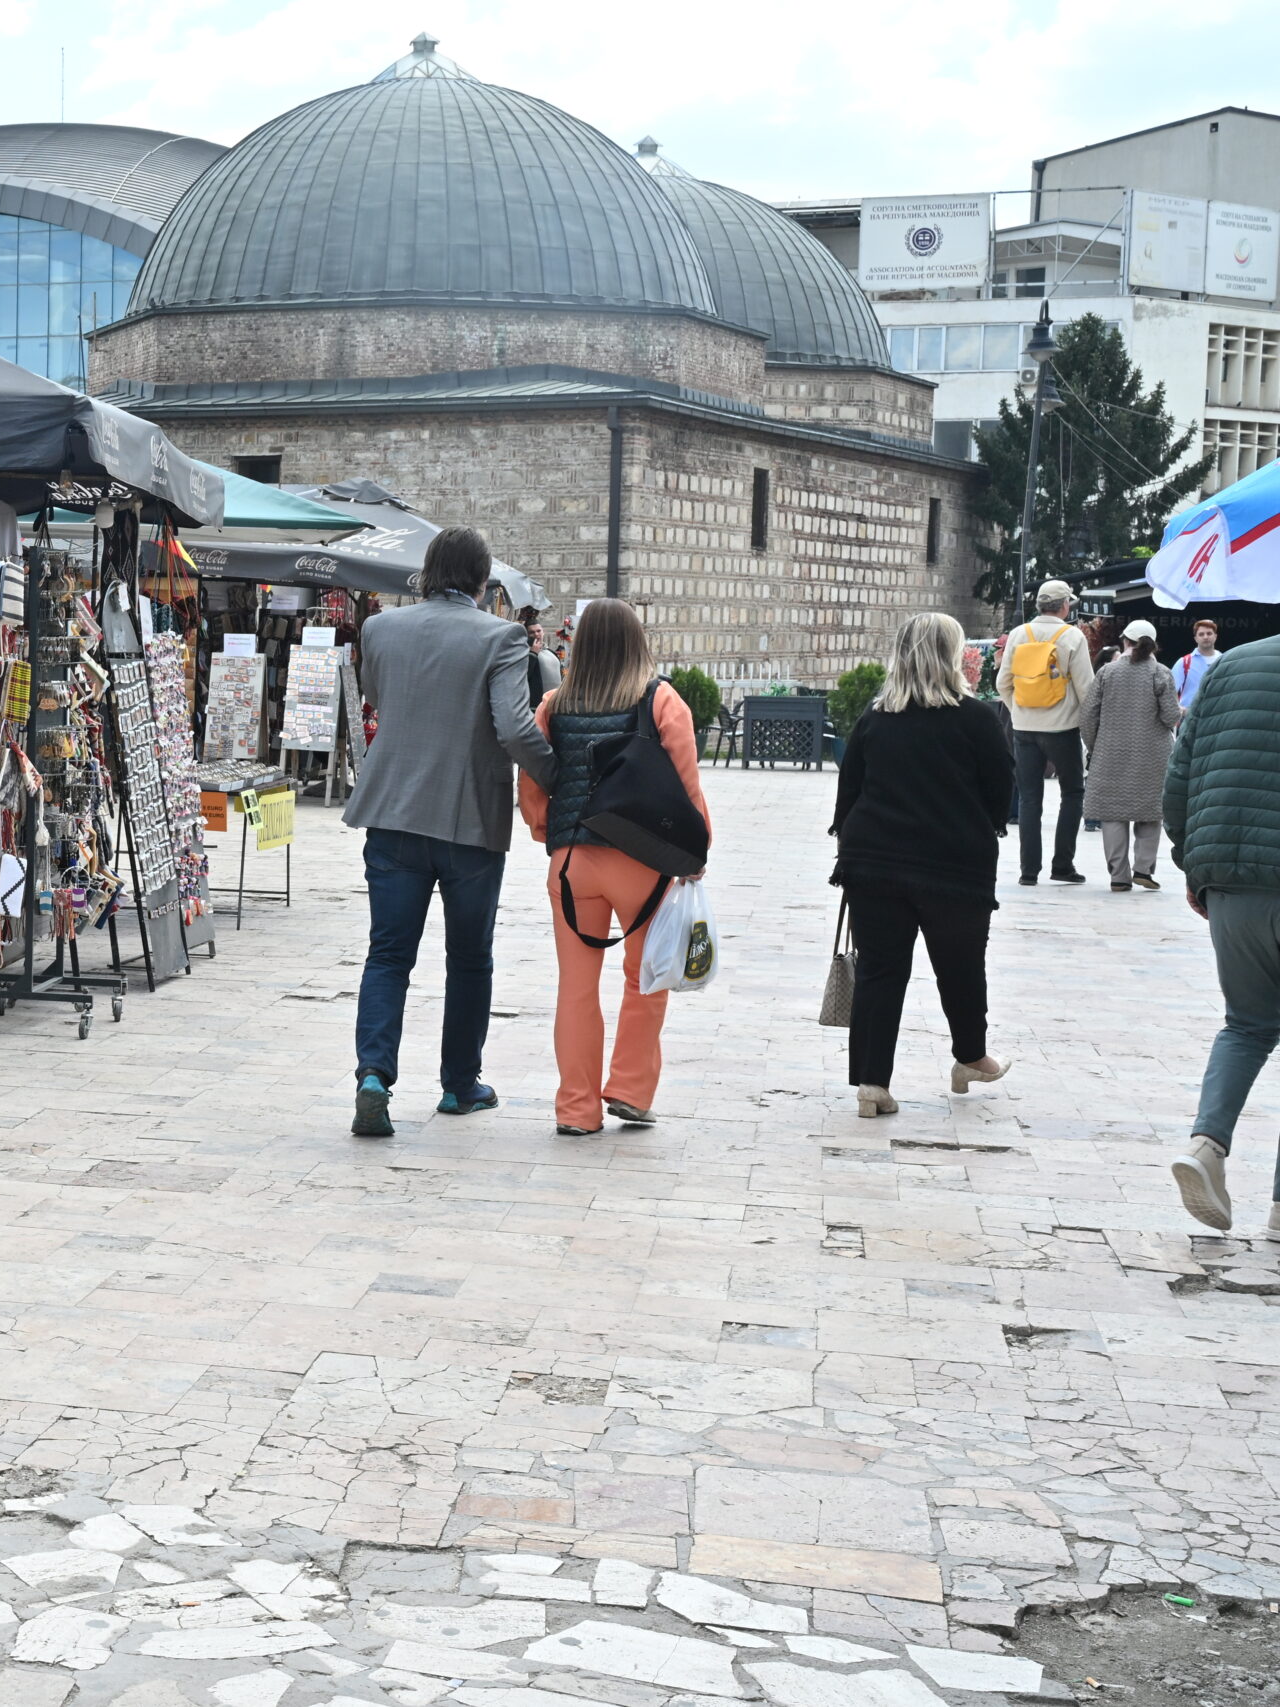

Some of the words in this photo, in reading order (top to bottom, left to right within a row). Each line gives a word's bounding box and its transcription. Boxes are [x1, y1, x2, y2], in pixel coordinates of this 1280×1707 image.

[872, 205, 894, 213] СОЈУЗ
[895, 204, 905, 212] НА
[907, 202, 978, 211] СМЕТКОВОДИТЕЛИ
[882, 212, 928, 220] РЕПУБЛИКА
[929, 210, 980, 219] МАКЕДОНИЈА
[869, 265, 915, 273] ASSOCIATION
[927, 264, 977, 272] ACCOUNTANTS
[891, 272, 925, 280] REPUBLIC
[936, 271, 979, 279] MACEDONIA
[294, 555, 340, 573] Coca-Cola
